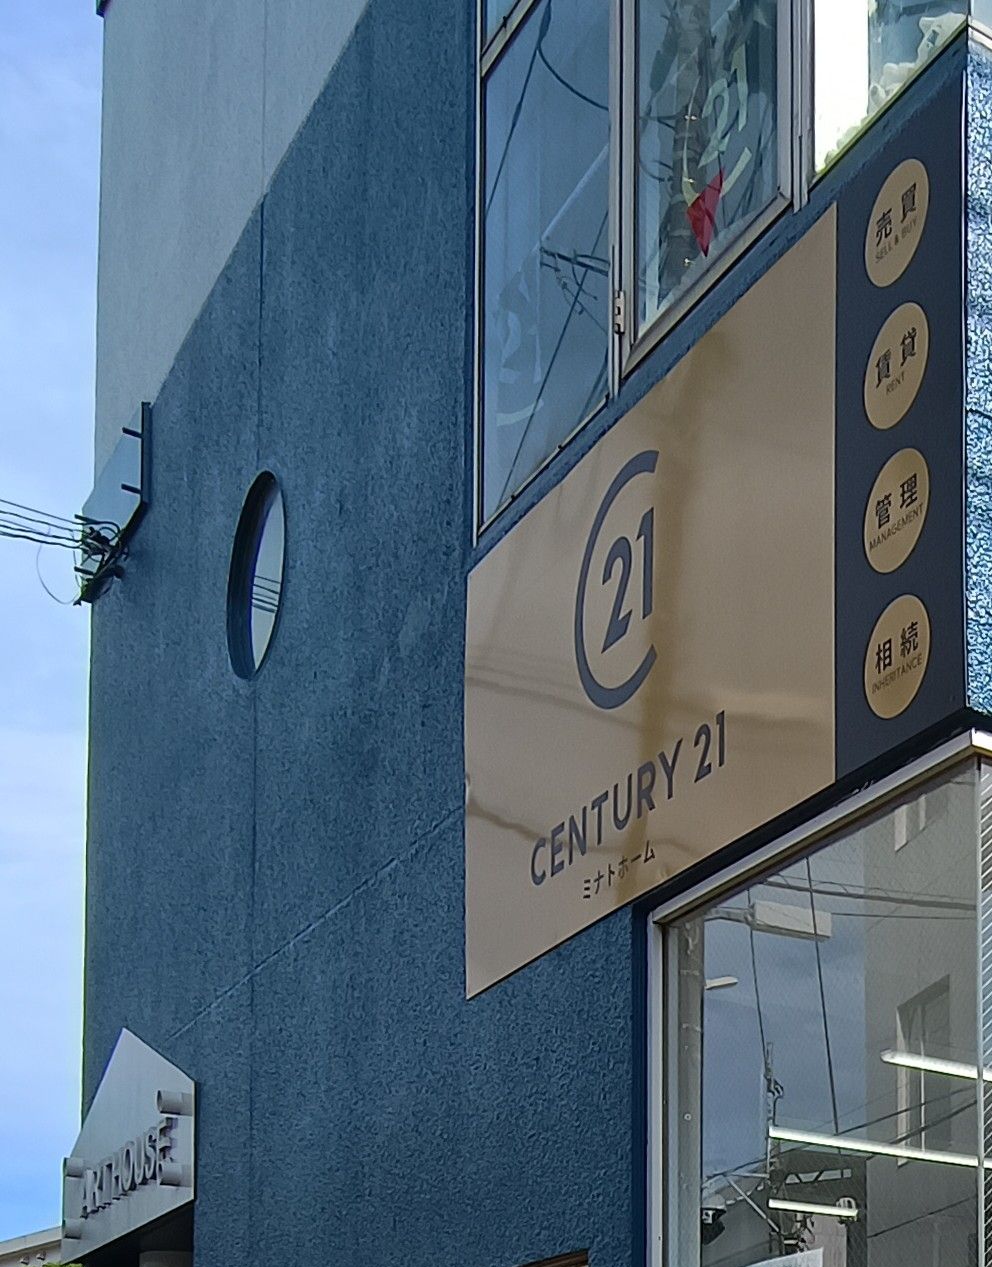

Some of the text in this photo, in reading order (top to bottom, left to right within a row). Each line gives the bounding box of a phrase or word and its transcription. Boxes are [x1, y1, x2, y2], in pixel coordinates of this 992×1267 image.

[874, 242, 893, 264] SELL
[901, 215, 918, 241] BUY
[875, 182, 917, 247] 売買
[875, 326, 917, 388] 賃貸
[885, 371, 906, 396] RENT
[869, 502, 924, 550] MANAGEMENT
[875, 473, 918, 529] 管理
[601, 506, 655, 654] 21
[871, 652, 923, 694] INHERITANCE
[875, 621, 919, 674] 相続
[530, 710, 726, 887] CENTURY 21
[583, 839, 656, 899] ミナトホーム
